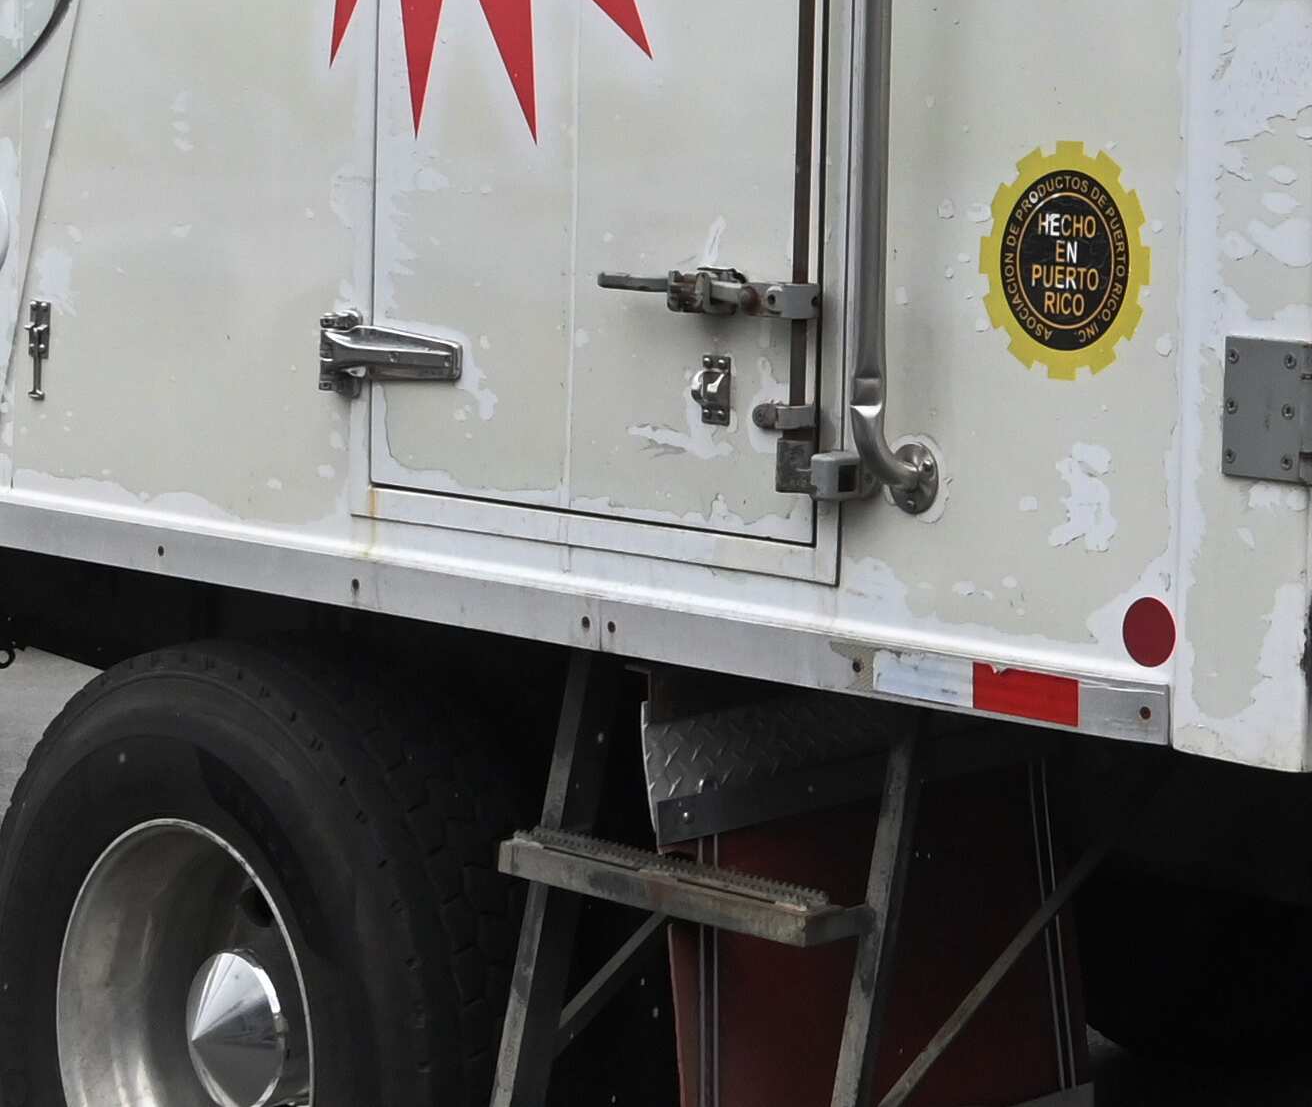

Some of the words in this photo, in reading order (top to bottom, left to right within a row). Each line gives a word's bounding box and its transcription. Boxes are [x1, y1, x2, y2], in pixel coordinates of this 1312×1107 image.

[1006, 221, 1021, 247] DE
[1015, 175, 1089, 222] PRODUCTOS
[1089, 188, 1107, 208] DE
[1105, 207, 1126, 278] PUERTO
[1037, 213, 1096, 238] HECHO
[1055, 240, 1078, 264] EN
[1031, 263, 1100, 291] PUERTO
[1043, 292, 1085, 316] RICO
